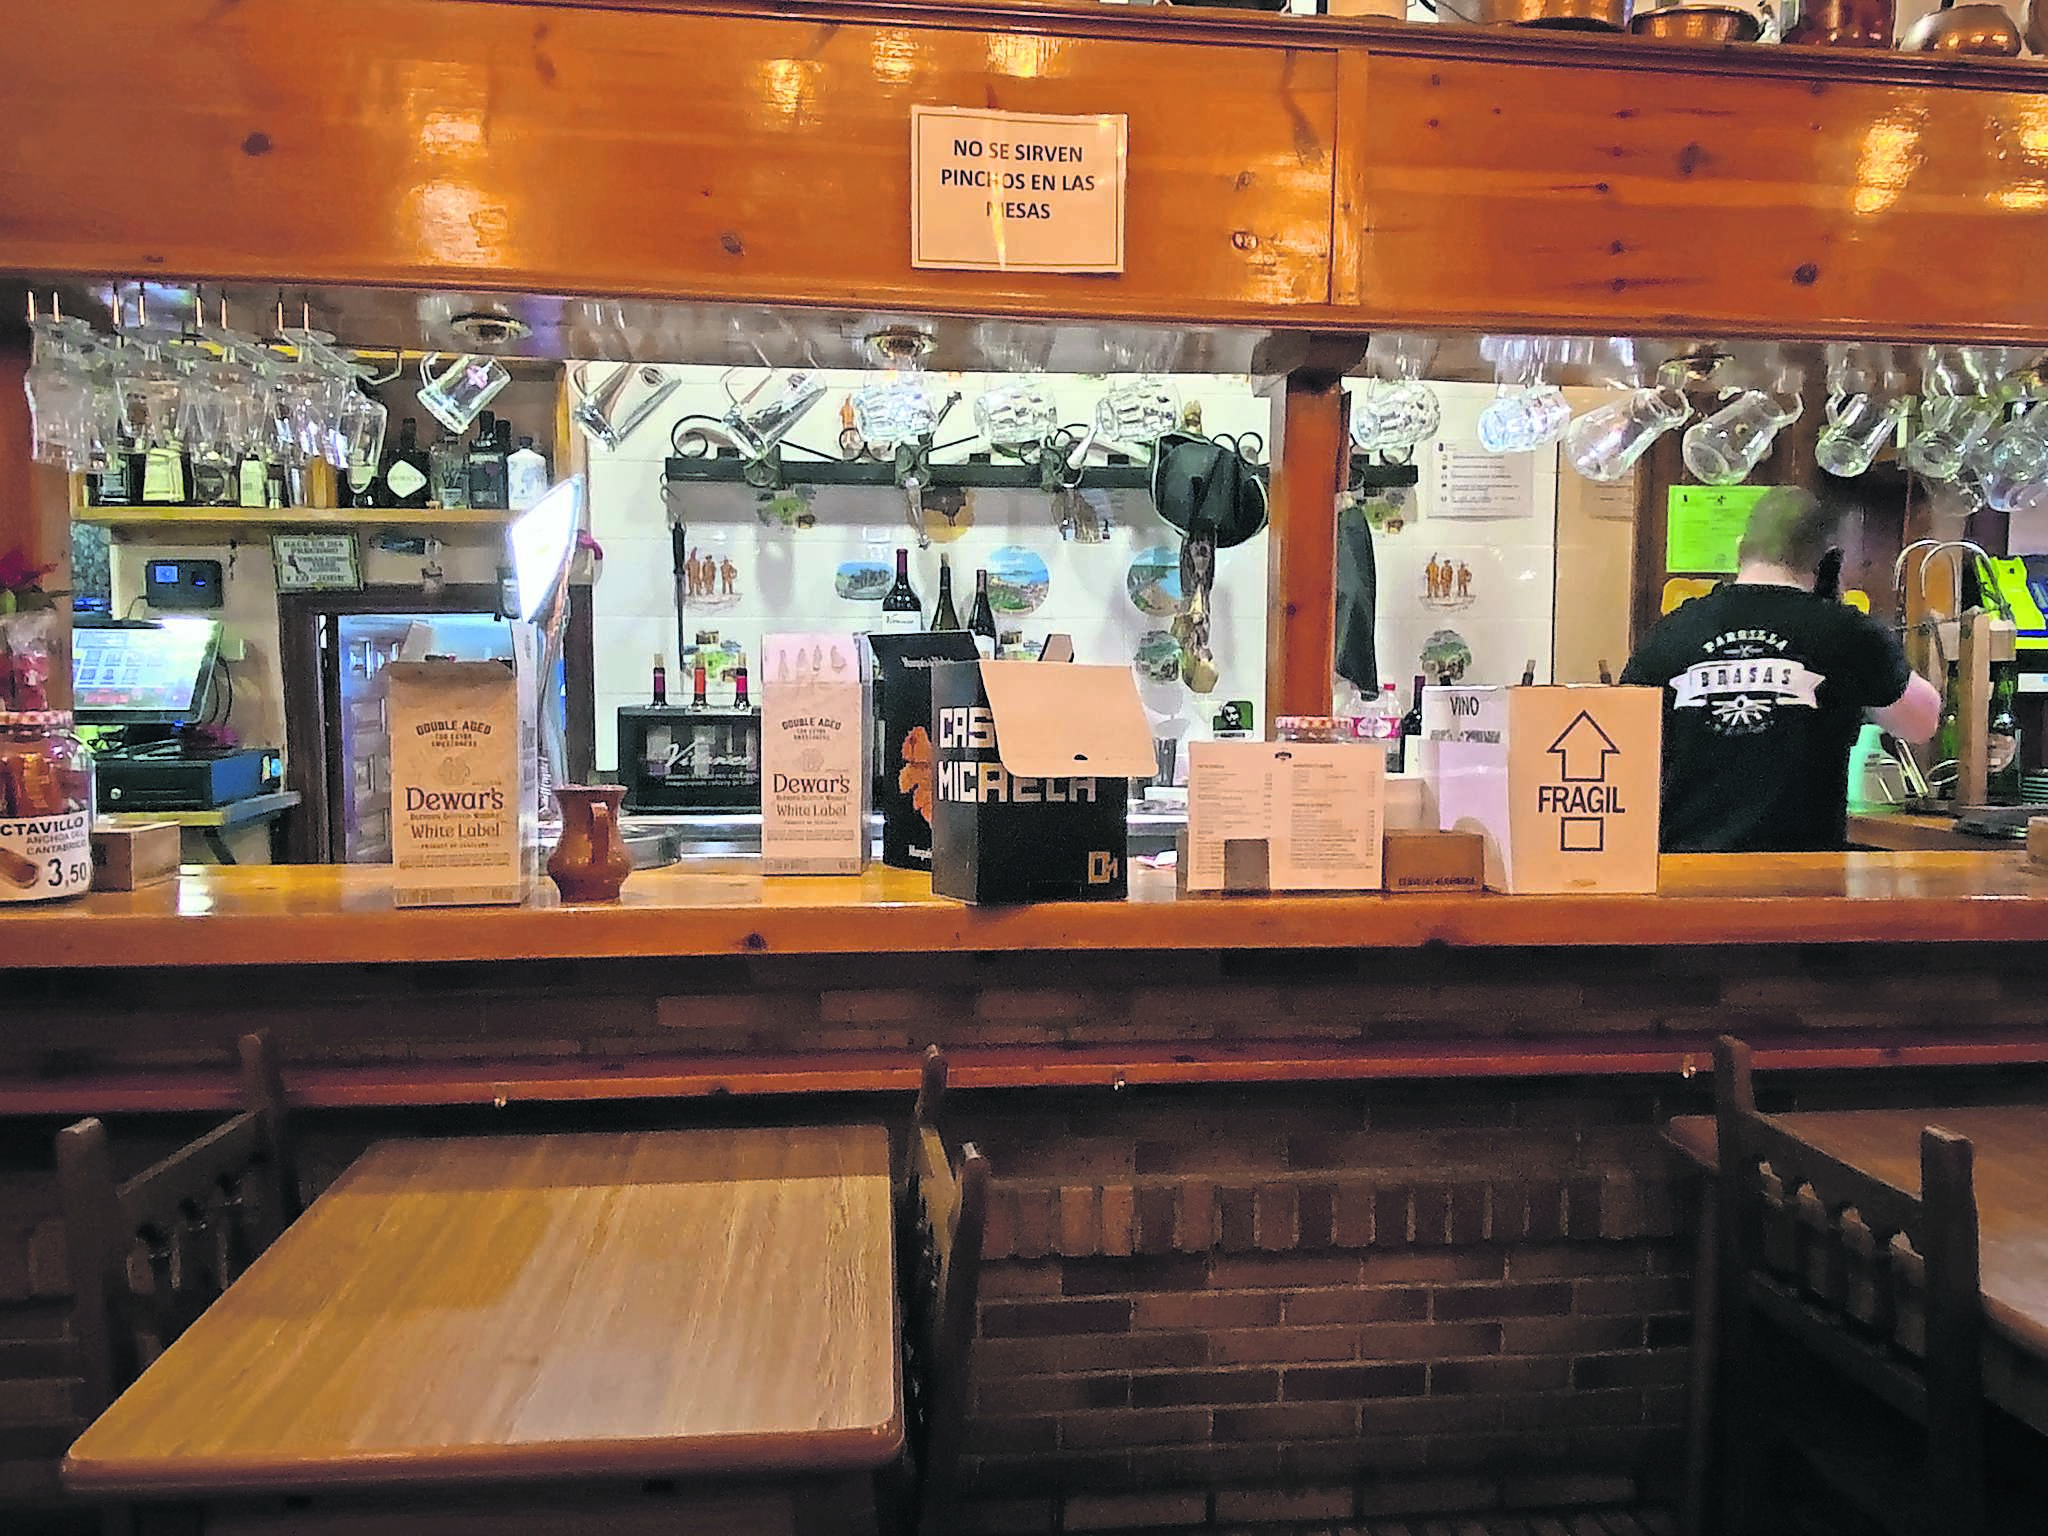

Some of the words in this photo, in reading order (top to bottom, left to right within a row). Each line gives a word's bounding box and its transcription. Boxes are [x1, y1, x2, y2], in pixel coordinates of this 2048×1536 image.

[953, 139, 983, 157] NO
[988, 142, 1009, 159] SE
[1014, 144, 1083, 162] SIRVEN
[941, 169, 1025, 190] PINCHOS
[1031, 174, 1055, 191] EN
[1062, 175, 1095, 191] LAS
[1702, 629, 1789, 653] PARRILLA
[1700, 666, 1792, 687] BRASAS
[1449, 696, 1480, 716] VINO
[415, 720, 457, 735] DOUBLE
[461, 720, 492, 735] AGED
[781, 717, 815, 730] DOUBLE
[774, 773, 850, 794] Dewar's
[405, 786, 504, 811] Dewar's
[1538, 786, 1625, 814] FRAGIL
[776, 804, 811, 817] White
[813, 804, 847, 817] Label
[26, 834, 70, 845] ANCHOA
[411, 823, 454, 839] White
[458, 822, 500, 838] Label
[48, 858, 87, 888] 3,50
